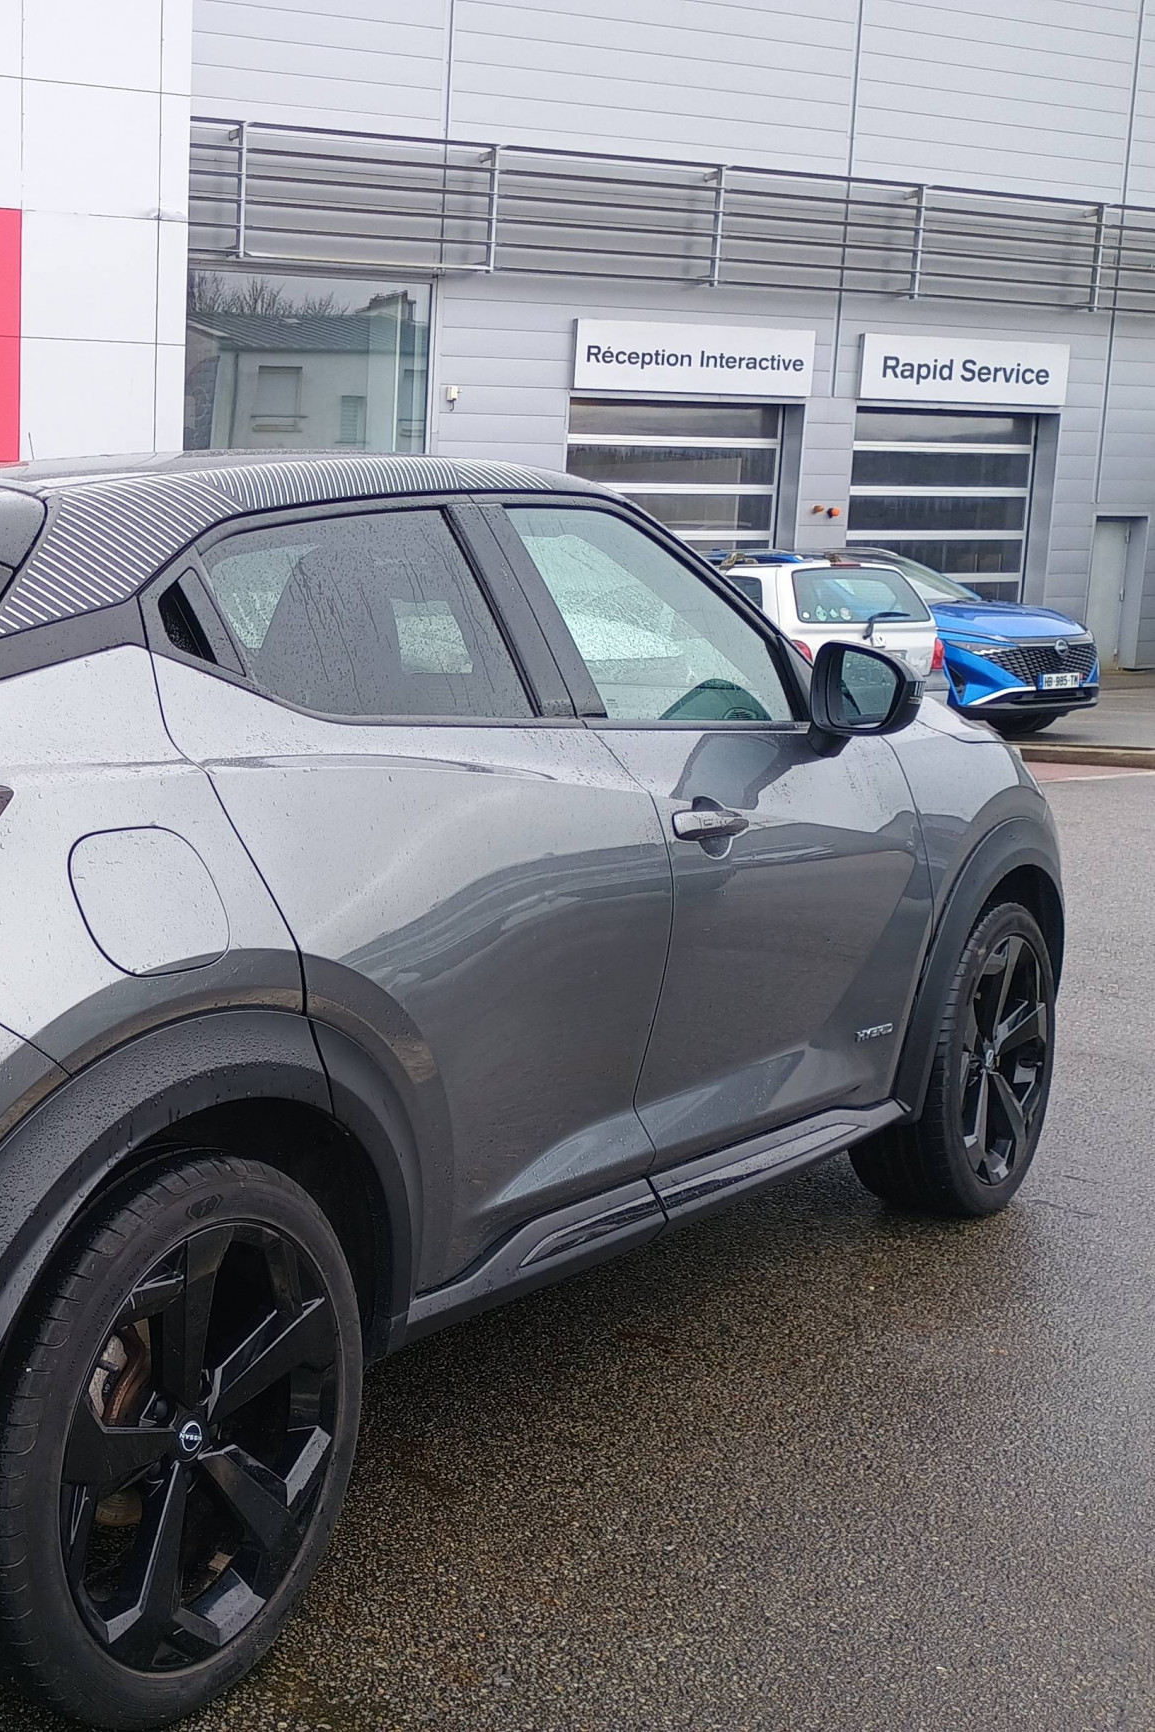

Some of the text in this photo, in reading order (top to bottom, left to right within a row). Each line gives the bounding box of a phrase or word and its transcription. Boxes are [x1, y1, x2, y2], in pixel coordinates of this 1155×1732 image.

[586, 344, 804, 373] Réception Interactive
[882, 355, 1050, 387] Rapid Service
